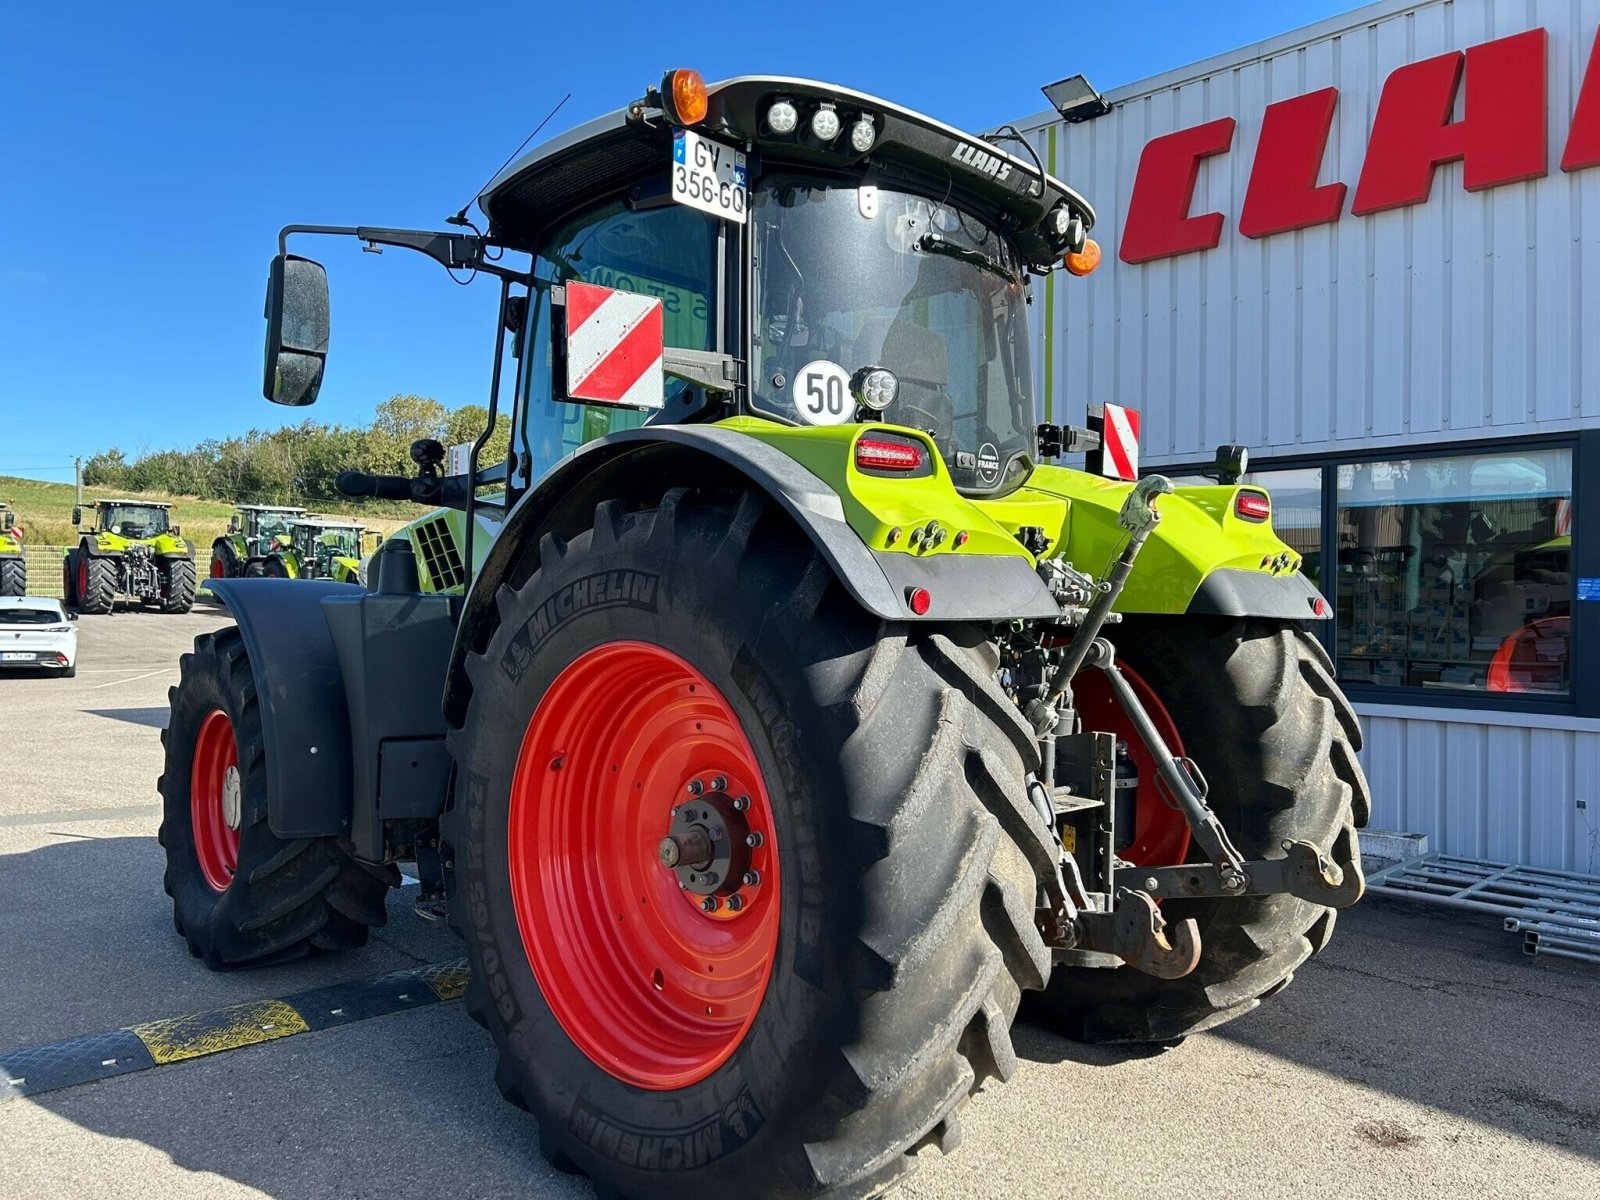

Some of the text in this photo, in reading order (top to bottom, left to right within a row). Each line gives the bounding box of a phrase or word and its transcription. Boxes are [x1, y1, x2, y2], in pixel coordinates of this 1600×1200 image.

[951, 141, 1013, 181] CLAAS
[1119, 24, 1600, 265] CLA
[676, 165, 744, 214] 356-GQ
[806, 372, 844, 415] 50
[977, 459, 999, 470] FRANCE
[527, 572, 657, 647] MICHELIN
[569, 1107, 724, 1172] MICHELIN
